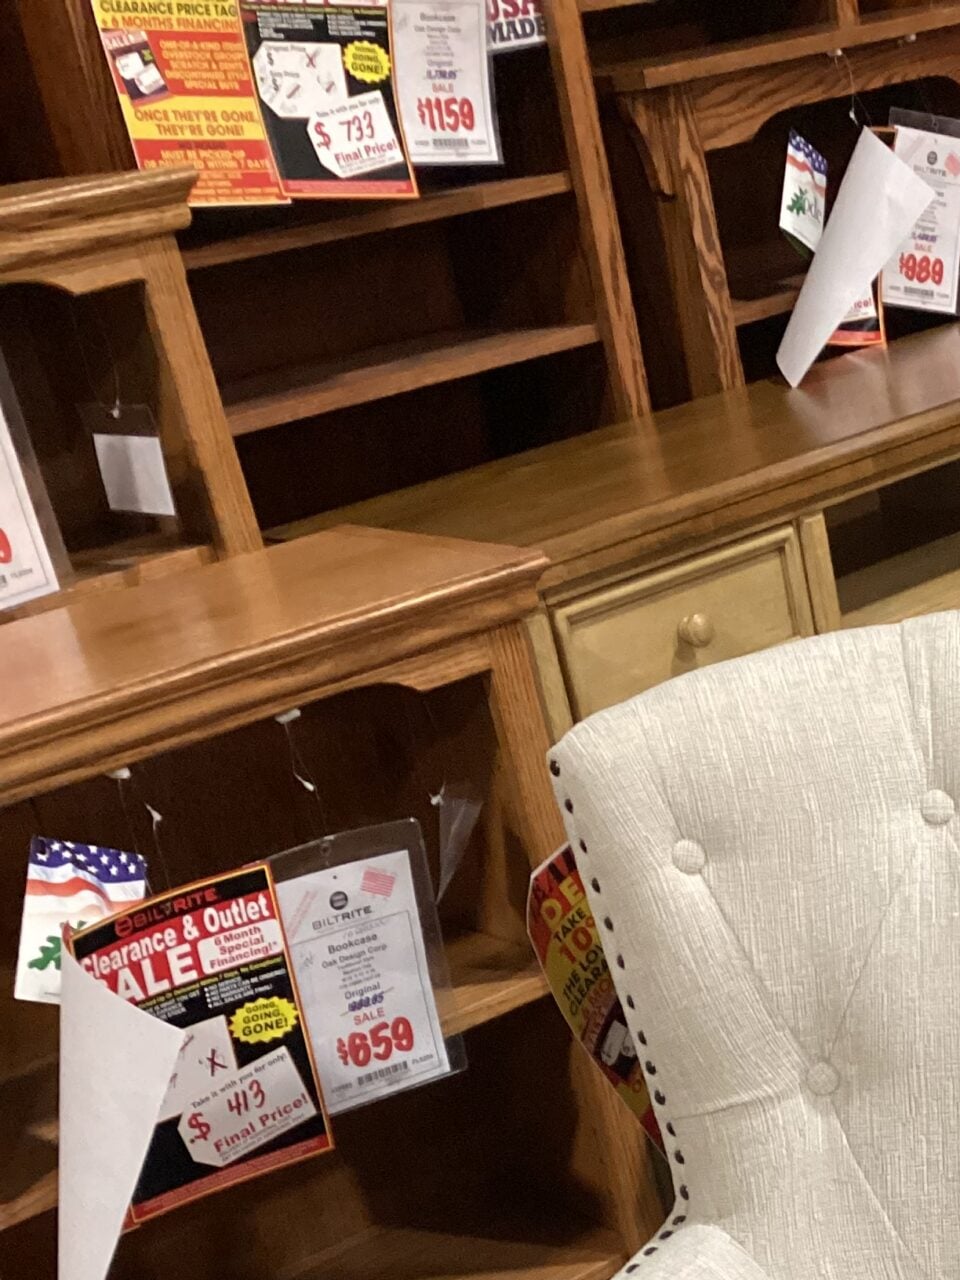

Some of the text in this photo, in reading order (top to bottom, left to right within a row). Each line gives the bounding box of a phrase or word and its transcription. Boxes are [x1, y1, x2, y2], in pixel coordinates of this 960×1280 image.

[100, 1, 174, 15] CLEARANCE
[177, 3, 211, 16] PRICE
[122, 16, 174, 29] MONTHS
[135, 110, 170, 122] ONCE
[174, 110, 218, 122] THEY'RE
[417, 96, 475, 133] $1159
[156, 124, 245, 136] THEY'RE GONE!
[338, 110, 376, 142] 733
[334, 138, 398, 167] Final Price!
[182, 915, 200, 940] &
[203, 893, 271, 933] Outlet
[312, 905, 373, 931] BILTRITE
[554, 906, 587, 942] TAKE
[214, 926, 262, 947] 6 Month
[219, 935, 265, 955] Special
[327, 933, 378, 954] Bookcase
[322, 957, 337, 969] Oak
[338, 948, 366, 964] Design
[98, 943, 199, 1003] ALE
[344, 981, 381, 1000] Original
[242, 1010, 285, 1024] GOING,
[245, 1002, 278, 1014] GOING,
[353, 1007, 385, 1026] SALE
[242, 1018, 289, 1037] GONE!
[336, 1016, 414, 1067] $659
[191, 1096, 210, 1108] Take
[219, 1080, 237, 1093] with
[239, 1071, 254, 1084] you
[253, 1064, 266, 1074] for
[227, 1079, 266, 1116] 413
[213, 1122, 256, 1153] Final
[259, 1093, 310, 1128] Price!
